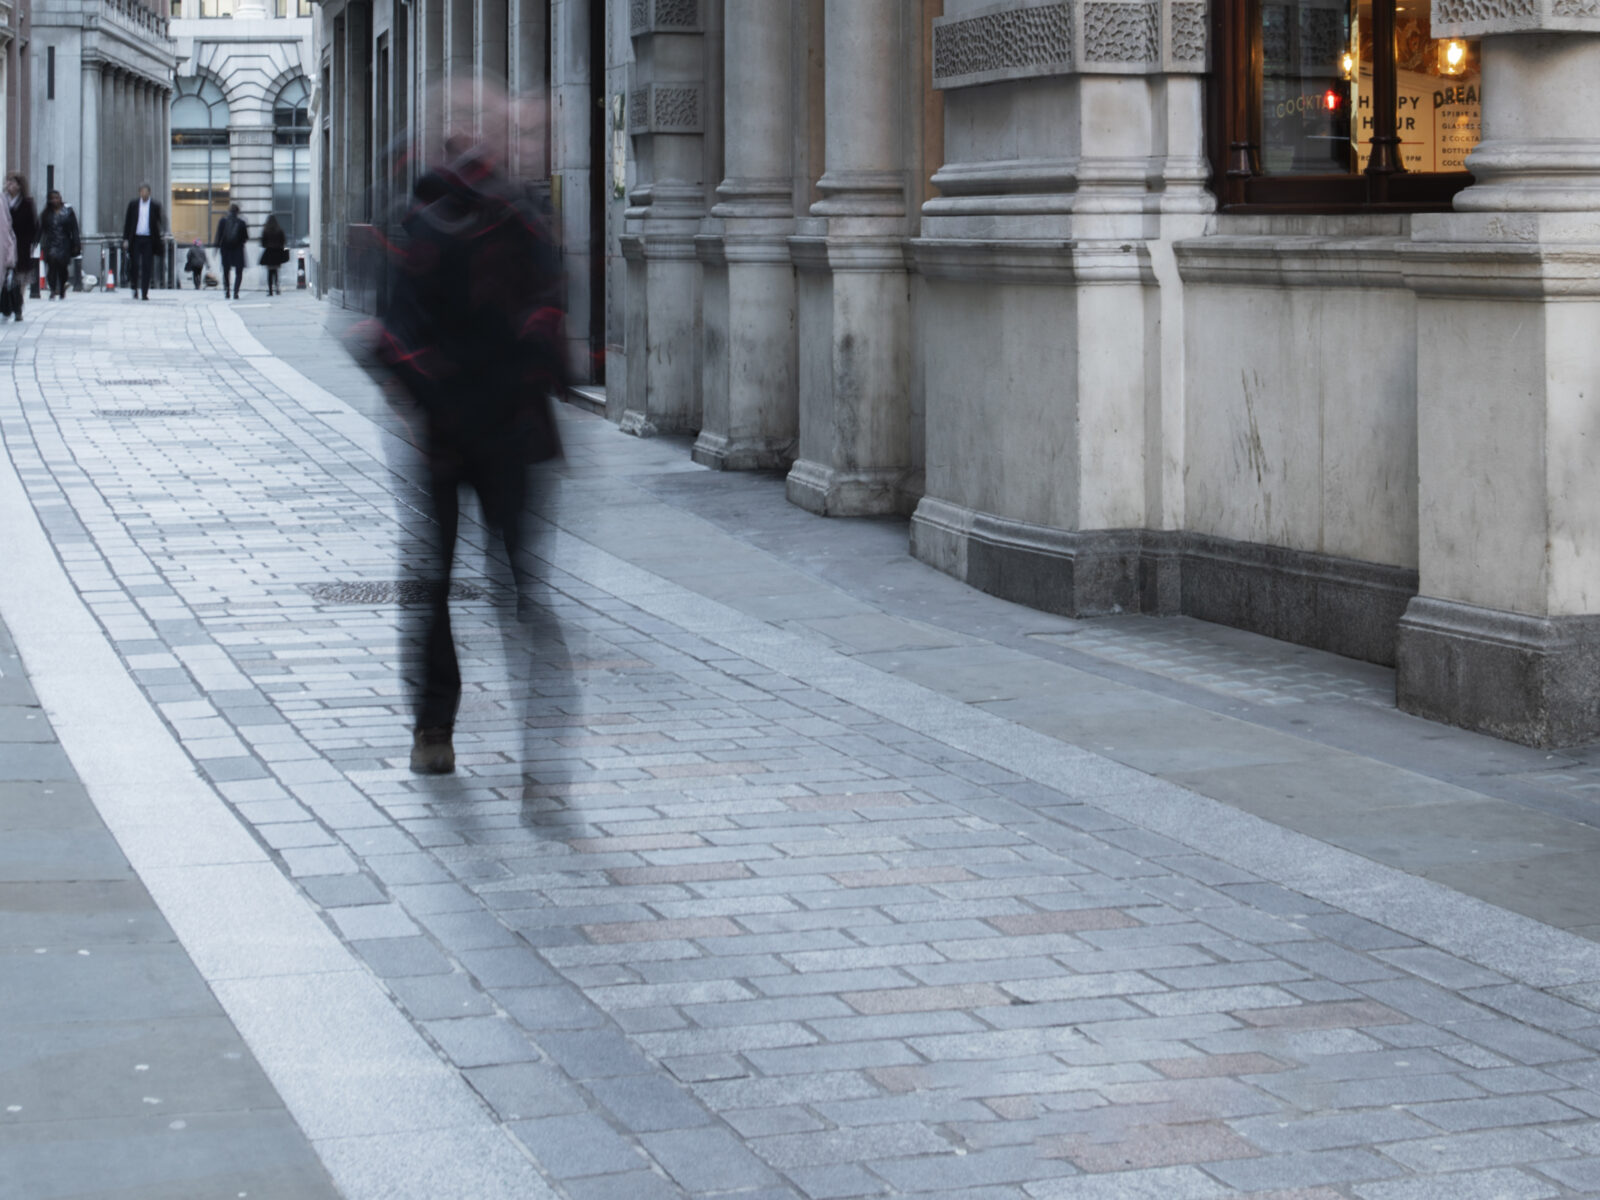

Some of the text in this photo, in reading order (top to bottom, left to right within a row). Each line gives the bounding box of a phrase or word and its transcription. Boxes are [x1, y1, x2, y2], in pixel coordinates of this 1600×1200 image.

[1358, 95, 1420, 110] HPY
[1433, 84, 1481, 109] DREA
[1362, 116, 1415, 130] HUR
